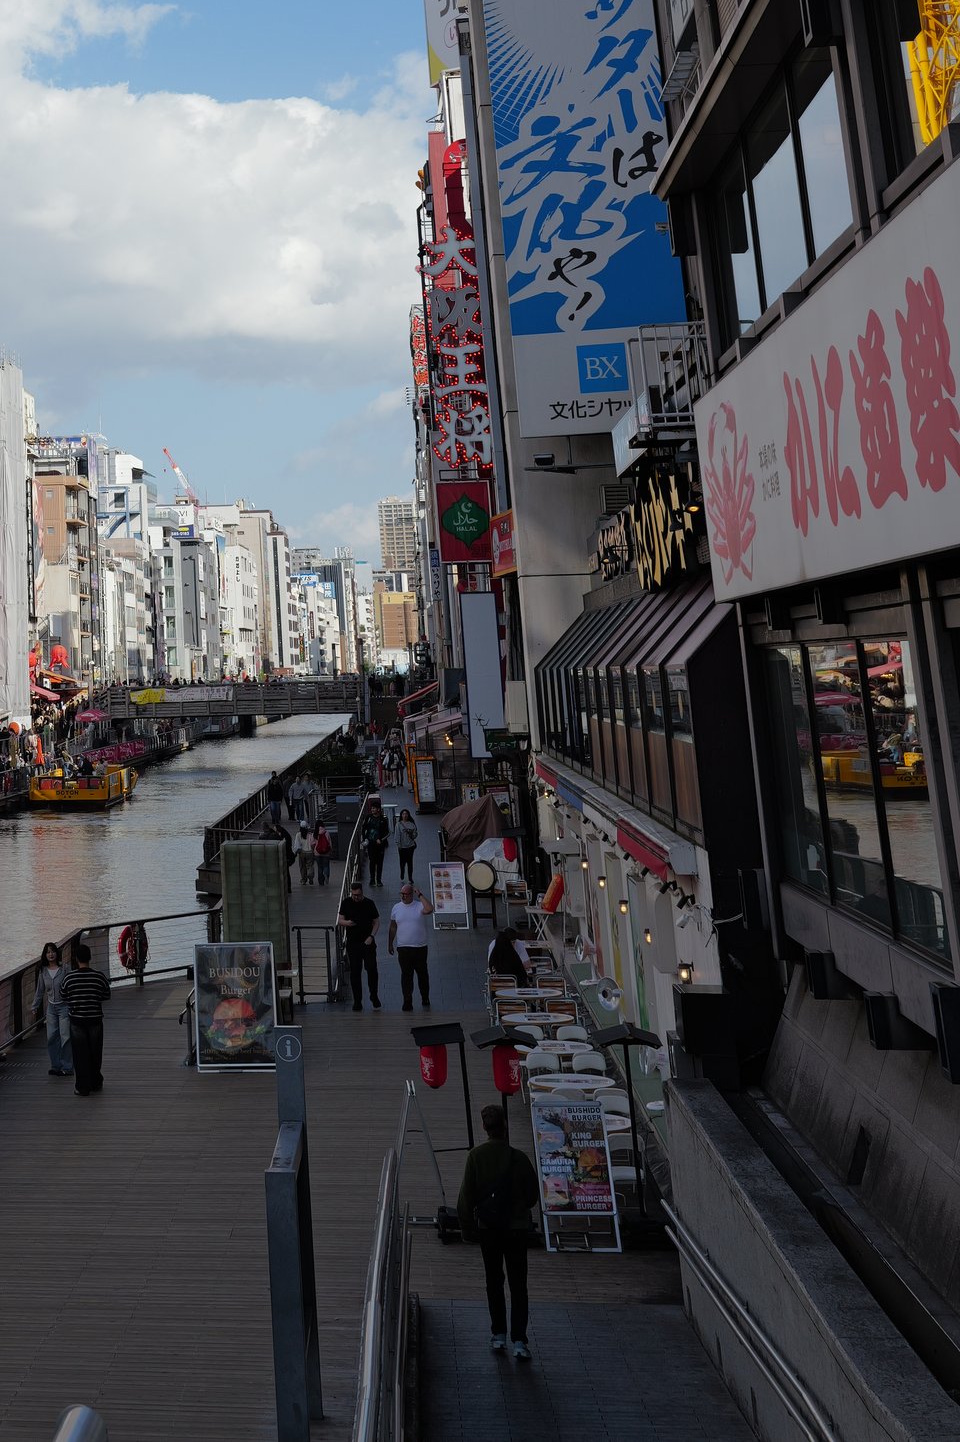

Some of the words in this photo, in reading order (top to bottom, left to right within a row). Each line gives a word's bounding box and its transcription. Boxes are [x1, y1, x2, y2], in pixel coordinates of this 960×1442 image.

[420, 226, 493, 466] 大阪王将
[584, 356, 622, 380] BX
[453, 511, 478, 526] حلال
[209, 967, 260, 978] BUSIDOU
[220, 985, 251, 997] Burger
[571, 1131, 592, 1139] KING
[572, 1139, 606, 1148] BURGER
[542, 1165, 572, 1173] BURGER
[576, 1202, 608, 1210] BURGER
